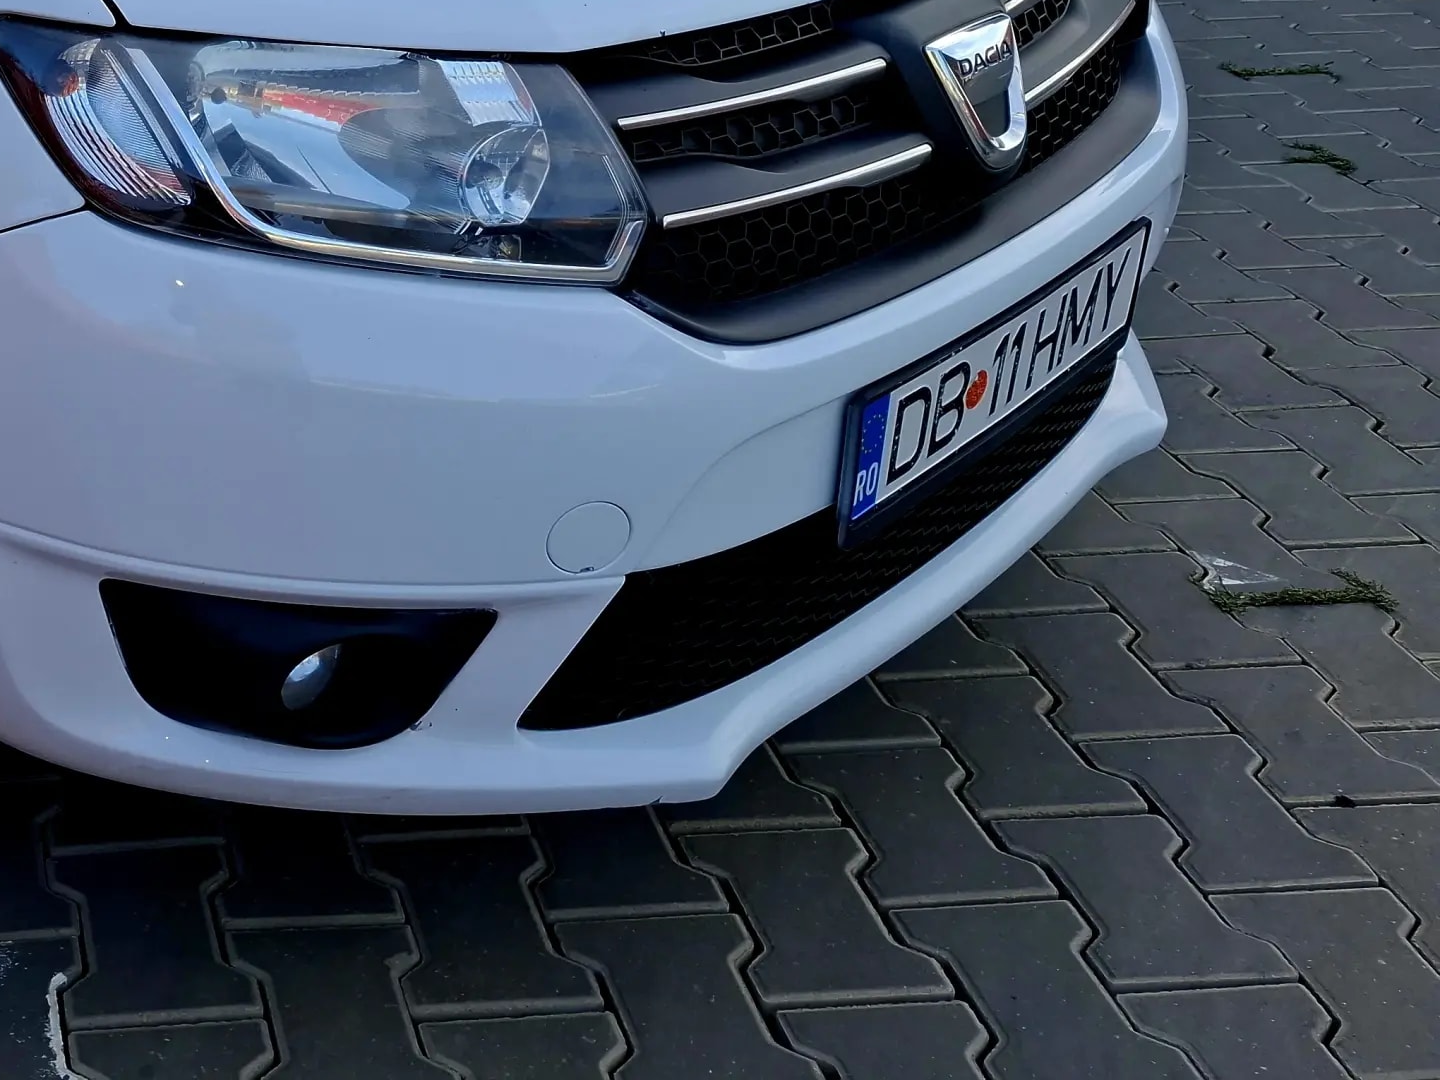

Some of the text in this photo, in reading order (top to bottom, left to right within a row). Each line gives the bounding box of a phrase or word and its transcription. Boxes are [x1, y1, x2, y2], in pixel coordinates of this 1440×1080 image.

[959, 41, 1013, 76] DACIA
[885, 361, 971, 486] DB
[853, 462, 879, 506] RO
